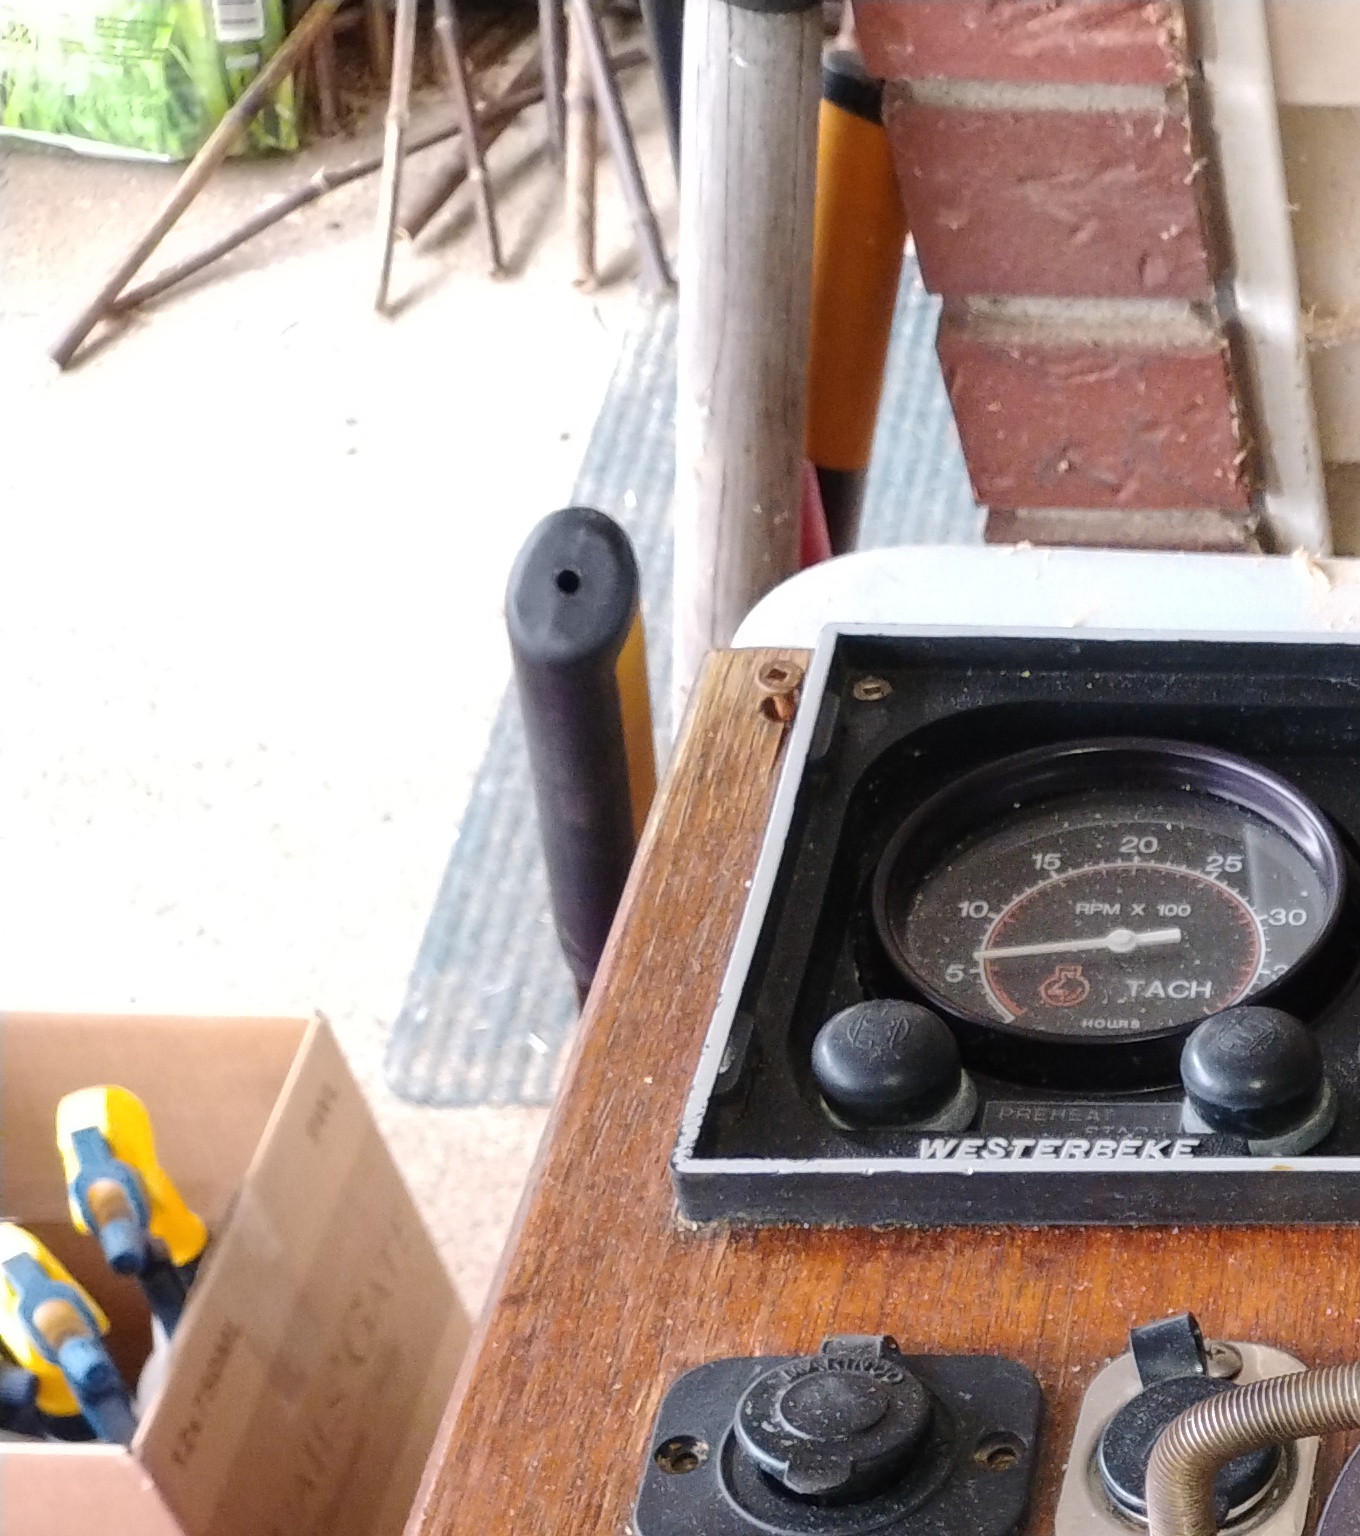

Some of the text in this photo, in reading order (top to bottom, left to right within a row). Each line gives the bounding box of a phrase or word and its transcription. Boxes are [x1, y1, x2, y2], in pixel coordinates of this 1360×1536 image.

[1120, 836, 1159, 855] 20
[1032, 853, 1062, 871] 15
[1206, 854, 1244, 874] 25
[959, 900, 990, 919] 10
[1075, 903, 1121, 917] RPM
[1157, 904, 1192, 918] 100
[1267, 908, 1308, 927] 30
[945, 964, 963, 983] 5
[1125, 979, 1213, 1000] TACH
[1082, 1017, 1141, 1030] HOURS
[918, 1136, 1201, 1160] WESTERBEKE
